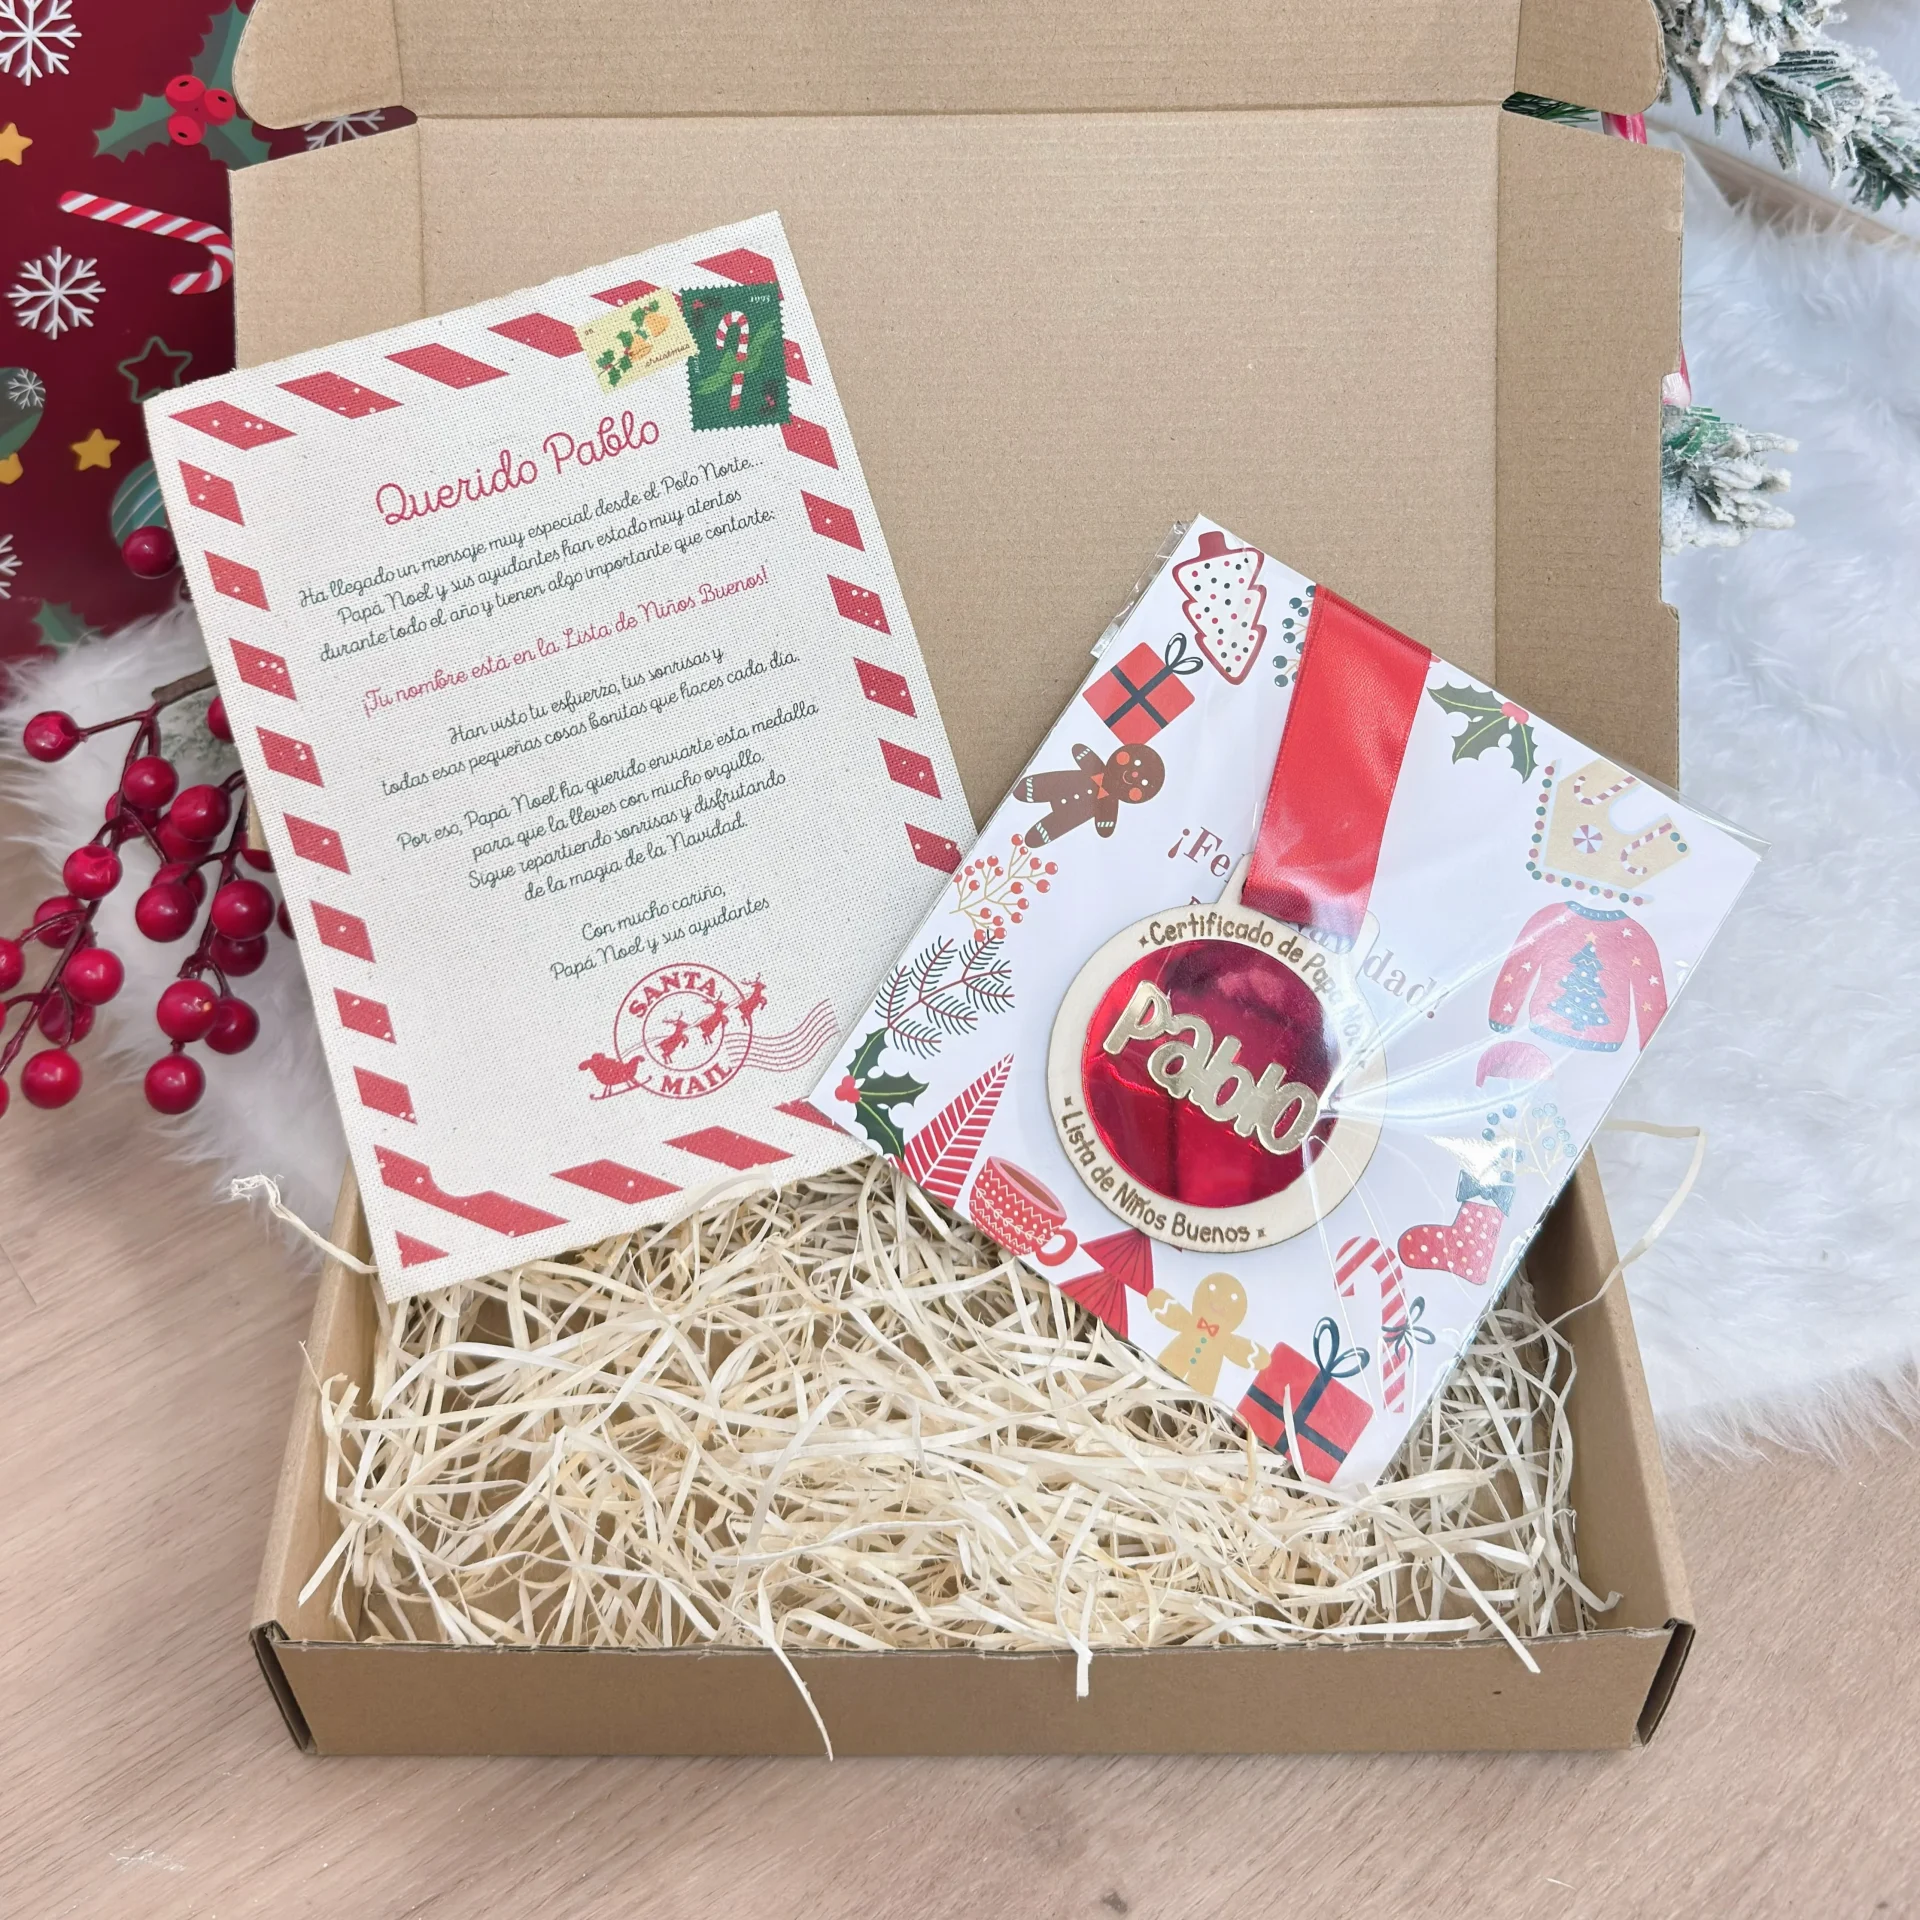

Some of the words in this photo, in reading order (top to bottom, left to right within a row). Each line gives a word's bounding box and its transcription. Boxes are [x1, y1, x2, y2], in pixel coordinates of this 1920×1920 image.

[376, 449, 538, 525] Querido
[543, 410, 660, 475] Pablo
[300, 590, 329, 607] Ha
[330, 566, 395, 597] llegado
[397, 562, 420, 579] un
[422, 543, 487, 571] mensaje
[489, 531, 524, 550] muy
[528, 504, 593, 540] especial
[595, 491, 641, 516] desde
[643, 482, 660, 501] el
[661, 471, 699, 494] Polo
[700, 457, 763, 481] Norte...
[338, 603, 385, 624] Papá
[385, 583, 433, 610] Noel
[436, 584, 448, 601] y
[451, 575, 475, 592] sus
[478, 547, 561, 585] ayudantes
[561, 539, 594, 562] han
[597, 517, 648, 544] estado
[650, 509, 684, 529] muy
[687, 489, 742, 517] atentos
[320, 631, 388, 662] durante
[389, 615, 427, 640] todo
[430, 608, 447, 627] el
[450, 604, 479, 622] año
[481, 600, 494, 617] y
[495, 582, 546, 607] tienen
[548, 571, 583, 593] algo
[586, 542, 671, 579] importante
[675, 533, 703, 553] que
[396, 669, 468, 700] nombre
[472, 654, 510, 678] está
[513, 649, 536, 665] en
[537, 637, 560, 658] la
[563, 623, 611, 648] Lista
[615, 611, 638, 632] de
[638, 596, 696, 622] Niños
[699, 565, 768, 604] Buenos!
[382, 772, 429, 796] todas
[432, 760, 466, 779] esas
[469, 737, 542, 774] pequeñas
[545, 721, 587, 744] cosas
[588, 700, 647, 730] bonitas
[650, 692, 679, 713] que
[680, 676, 724, 699] haces
[727, 659, 767, 684] cada
[447, 722, 488, 744] Han
[491, 709, 527, 732] visto
[529, 704, 548, 720] tu
[551, 681, 621, 713] esfuerzo,
[622, 674, 645, 689] tus
[649, 650, 711, 681] sonrisas
[713, 648, 724, 664] y
[397, 832, 431, 850] Por
[434, 823, 463, 839] eso,
[464, 805, 511, 828] Papá
[511, 786, 559, 812] Noel
[560, 781, 583, 799] ha
[586, 758, 646, 794] querido
[650, 738, 714, 769] enviarte
[717, 726, 749, 746] esta
[752, 701, 819, 734] medalla
[469, 864, 516, 888] Sigue
[520, 830, 612, 873] repartiendo
[615, 811, 678, 841] sonrisas
[680, 807, 692, 823] y
[694, 769, 786, 814] disfrutando
[472, 839, 514, 862] para
[517, 827, 546, 847] que
[548, 815, 568, 832] la
[569, 803, 617, 826] lleves
[620, 792, 649, 809] con
[651, 770, 701, 799] mucho
[525, 882, 546, 901] de
[548, 876, 567, 893] la
[569, 861, 622, 886] magia
[625, 849, 645, 867] de
[647, 842, 666, 860] la
[667, 811, 748, 851] Navidad.
[582, 923, 615, 941] Con
[618, 901, 669, 929] mucho
[673, 885, 726, 911] cariño,
[550, 955, 597, 980] Papá
[597, 936, 645, 962] Noel
[647, 938, 659, 954] y
[662, 928, 686, 944] sus
[689, 898, 770, 936] ayudantes
[629, 971, 716, 1018] SANTA
[1149, 911, 1274, 948] Certificado
[1277, 936, 1304, 963] de
[660, 1063, 733, 1095] MAIL
[1103, 980, 1320, 1155] Pablo
[1061, 1109, 1097, 1167] Lista
[1091, 1166, 1115, 1193] de
[1113, 1181, 1167, 1231] Niños
[1171, 1211, 1250, 1244] Buenos
